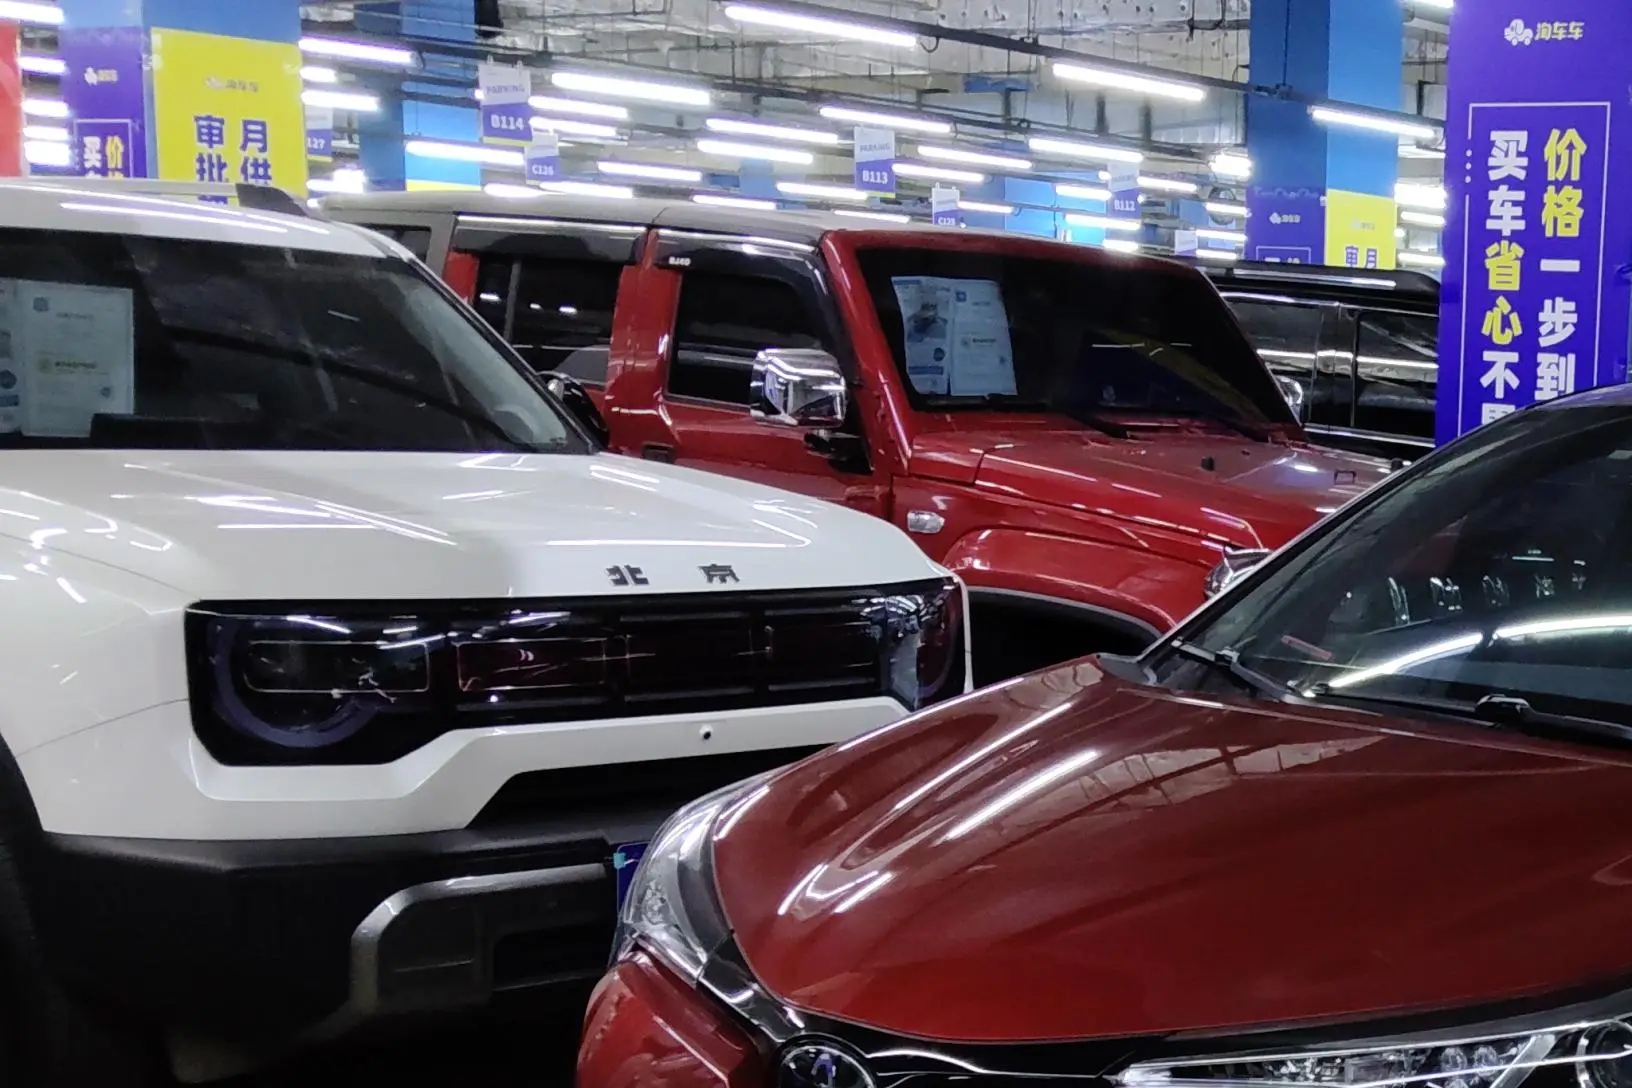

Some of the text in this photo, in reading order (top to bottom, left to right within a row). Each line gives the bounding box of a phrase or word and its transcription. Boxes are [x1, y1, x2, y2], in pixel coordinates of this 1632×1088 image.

[1535, 21, 1585, 40] 淘车车
[491, 115, 524, 130] B114
[862, 170, 888, 184] B113
[1534, 127, 1587, 401] 价格一步到
[605, 564, 740, 586] 北京
